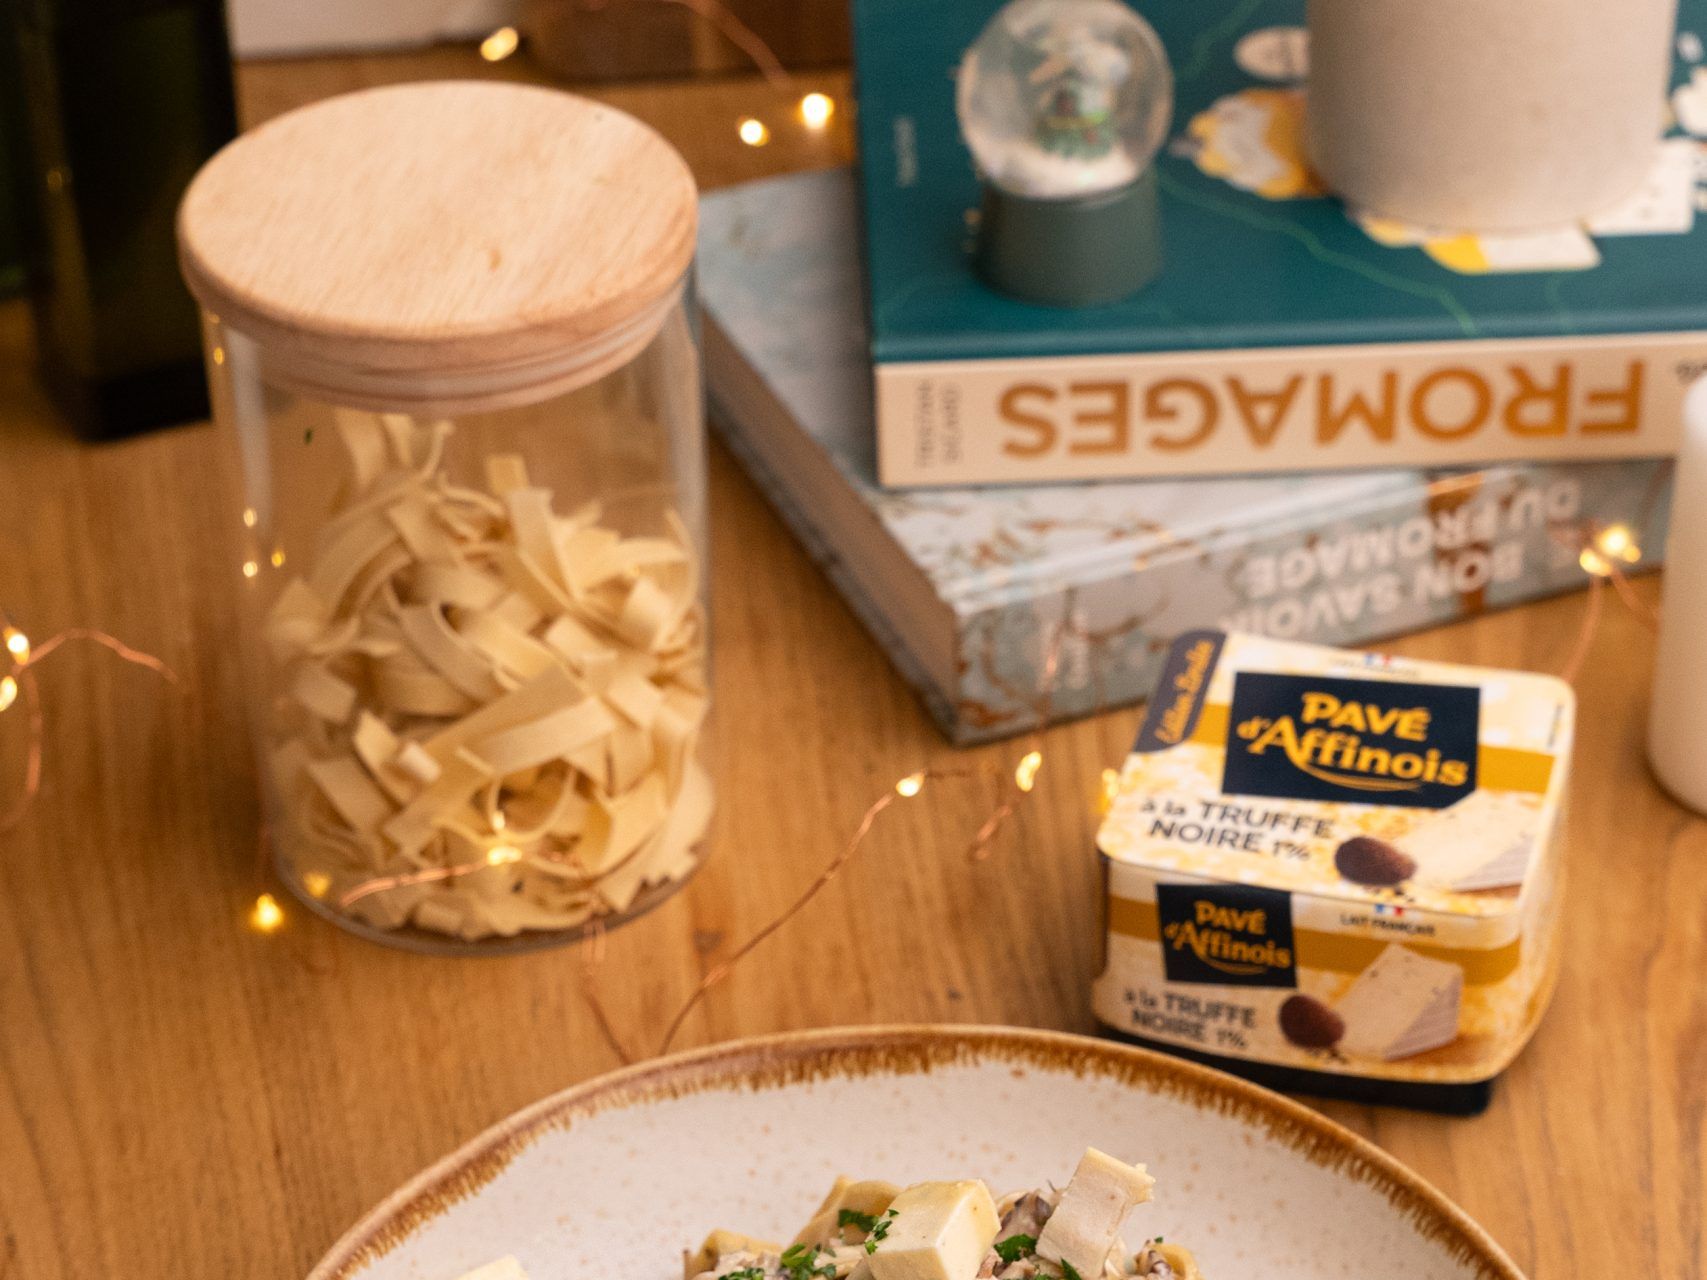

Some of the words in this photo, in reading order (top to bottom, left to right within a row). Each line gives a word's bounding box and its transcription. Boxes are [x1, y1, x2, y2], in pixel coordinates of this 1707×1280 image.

[997, 359, 1646, 459] FROMAGES
[1516, 477, 1583, 524] DU
[1247, 502, 1503, 598] FROMAGE
[1411, 539, 1524, 600] BON
[1301, 691, 1431, 742] PAVÉ
[1238, 716, 1469, 788] d'Affinois
[1149, 818, 1262, 853] NOIRE
[1271, 839, 1311, 861] 1%
[1199, 802, 1336, 839] TRUFFE
[1194, 900, 1266, 934] PAVÉ
[1164, 921, 1292, 970] d'Affinois
[1131, 1010, 1206, 1043] NOIRE
[1163, 991, 1257, 1028] TRUFFE
